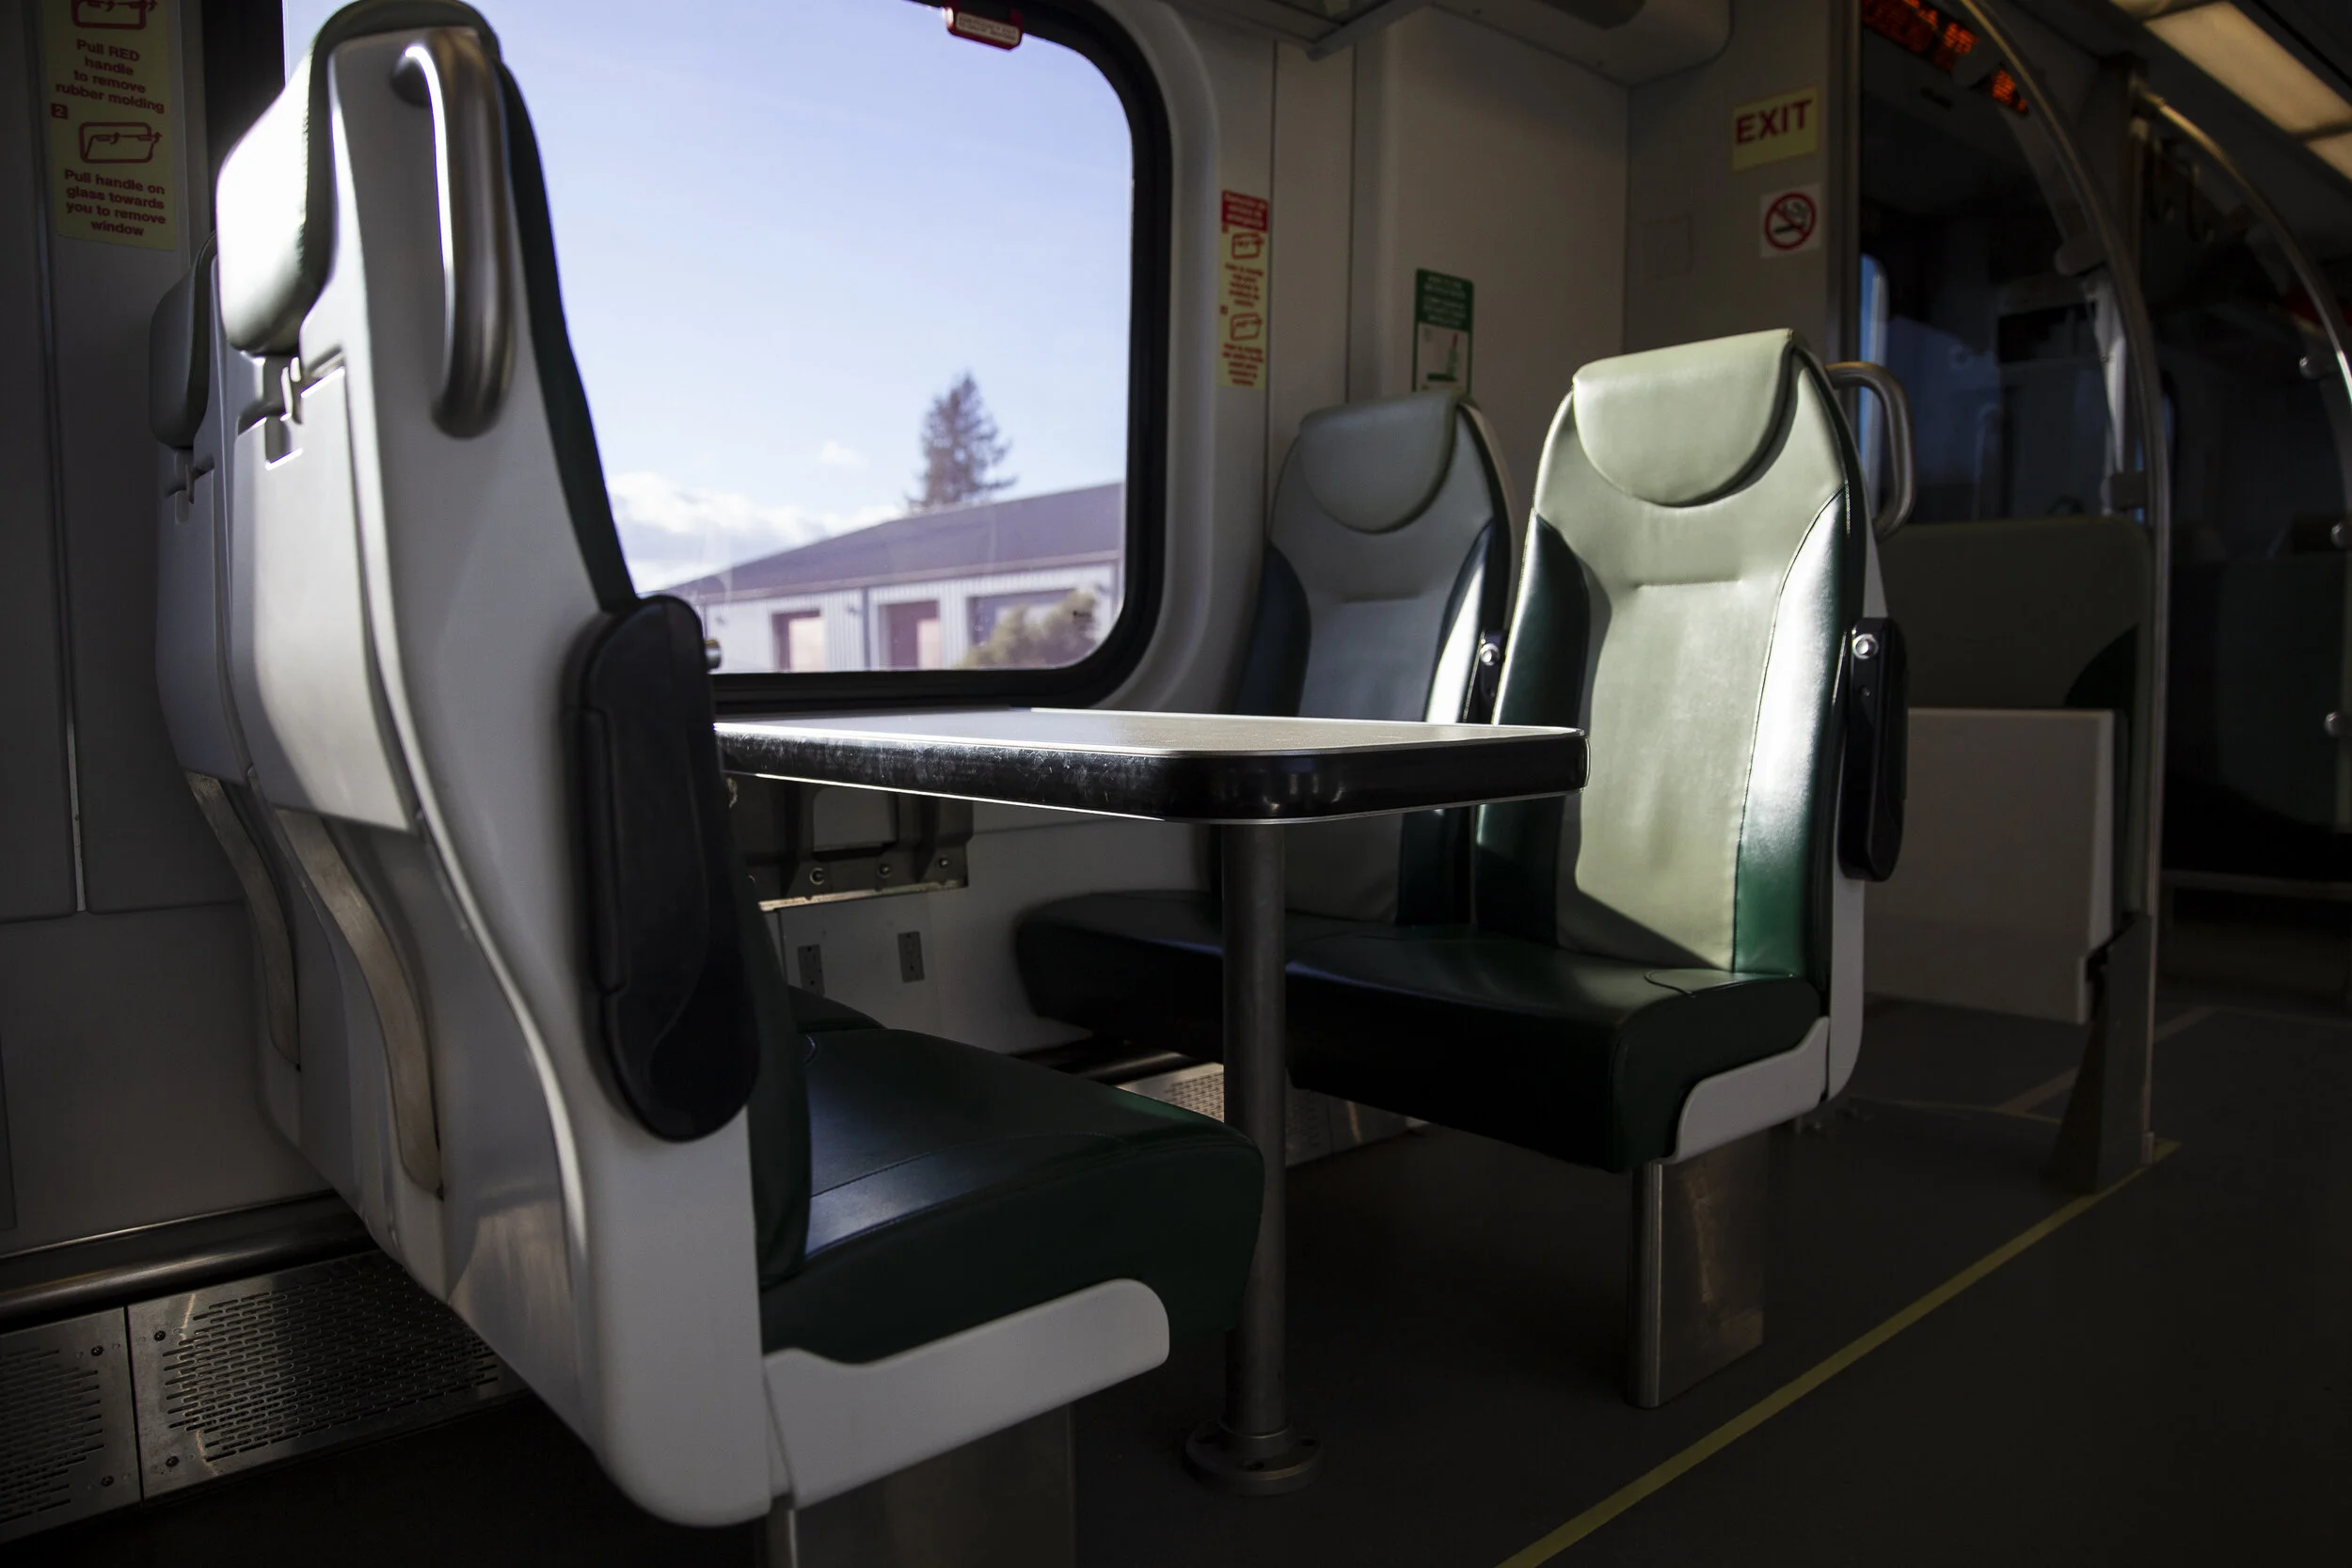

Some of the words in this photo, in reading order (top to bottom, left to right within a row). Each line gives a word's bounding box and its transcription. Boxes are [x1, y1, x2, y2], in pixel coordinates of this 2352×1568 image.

[76, 39, 103, 55] Pull
[109, 45, 140, 62] RED
[85, 56, 134, 76] handle
[73, 70, 88, 82] to
[92, 75, 146, 93] remove
[56, 82, 103, 101] rubber
[108, 92, 165, 114] molding
[1735, 99, 1814, 144] EXIT
[64, 168, 91, 183] Pull
[96, 174, 144, 192] handle
[148, 183, 166, 195] on
[66, 185, 105, 202] glass
[109, 192, 165, 210] towards
[66, 200, 92, 215] you
[97, 202, 111, 216] to
[115, 209, 167, 225] remove
[91, 219, 144, 236] window
